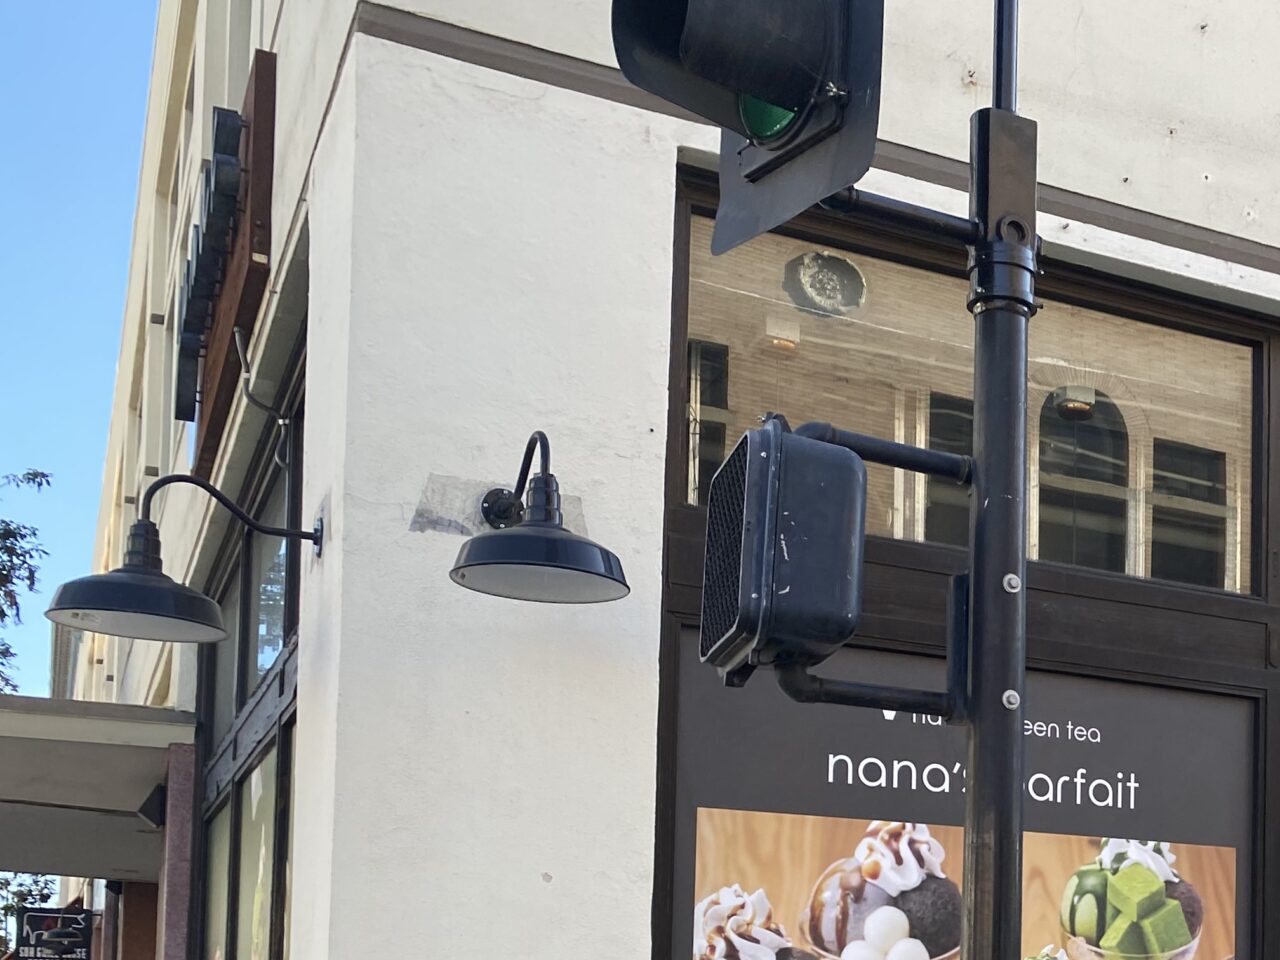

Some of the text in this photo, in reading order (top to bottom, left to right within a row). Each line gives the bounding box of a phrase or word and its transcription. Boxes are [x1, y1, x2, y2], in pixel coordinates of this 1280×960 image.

[1024, 719, 1101, 743] een tea
[828, 751, 1140, 809] nana' arfait
